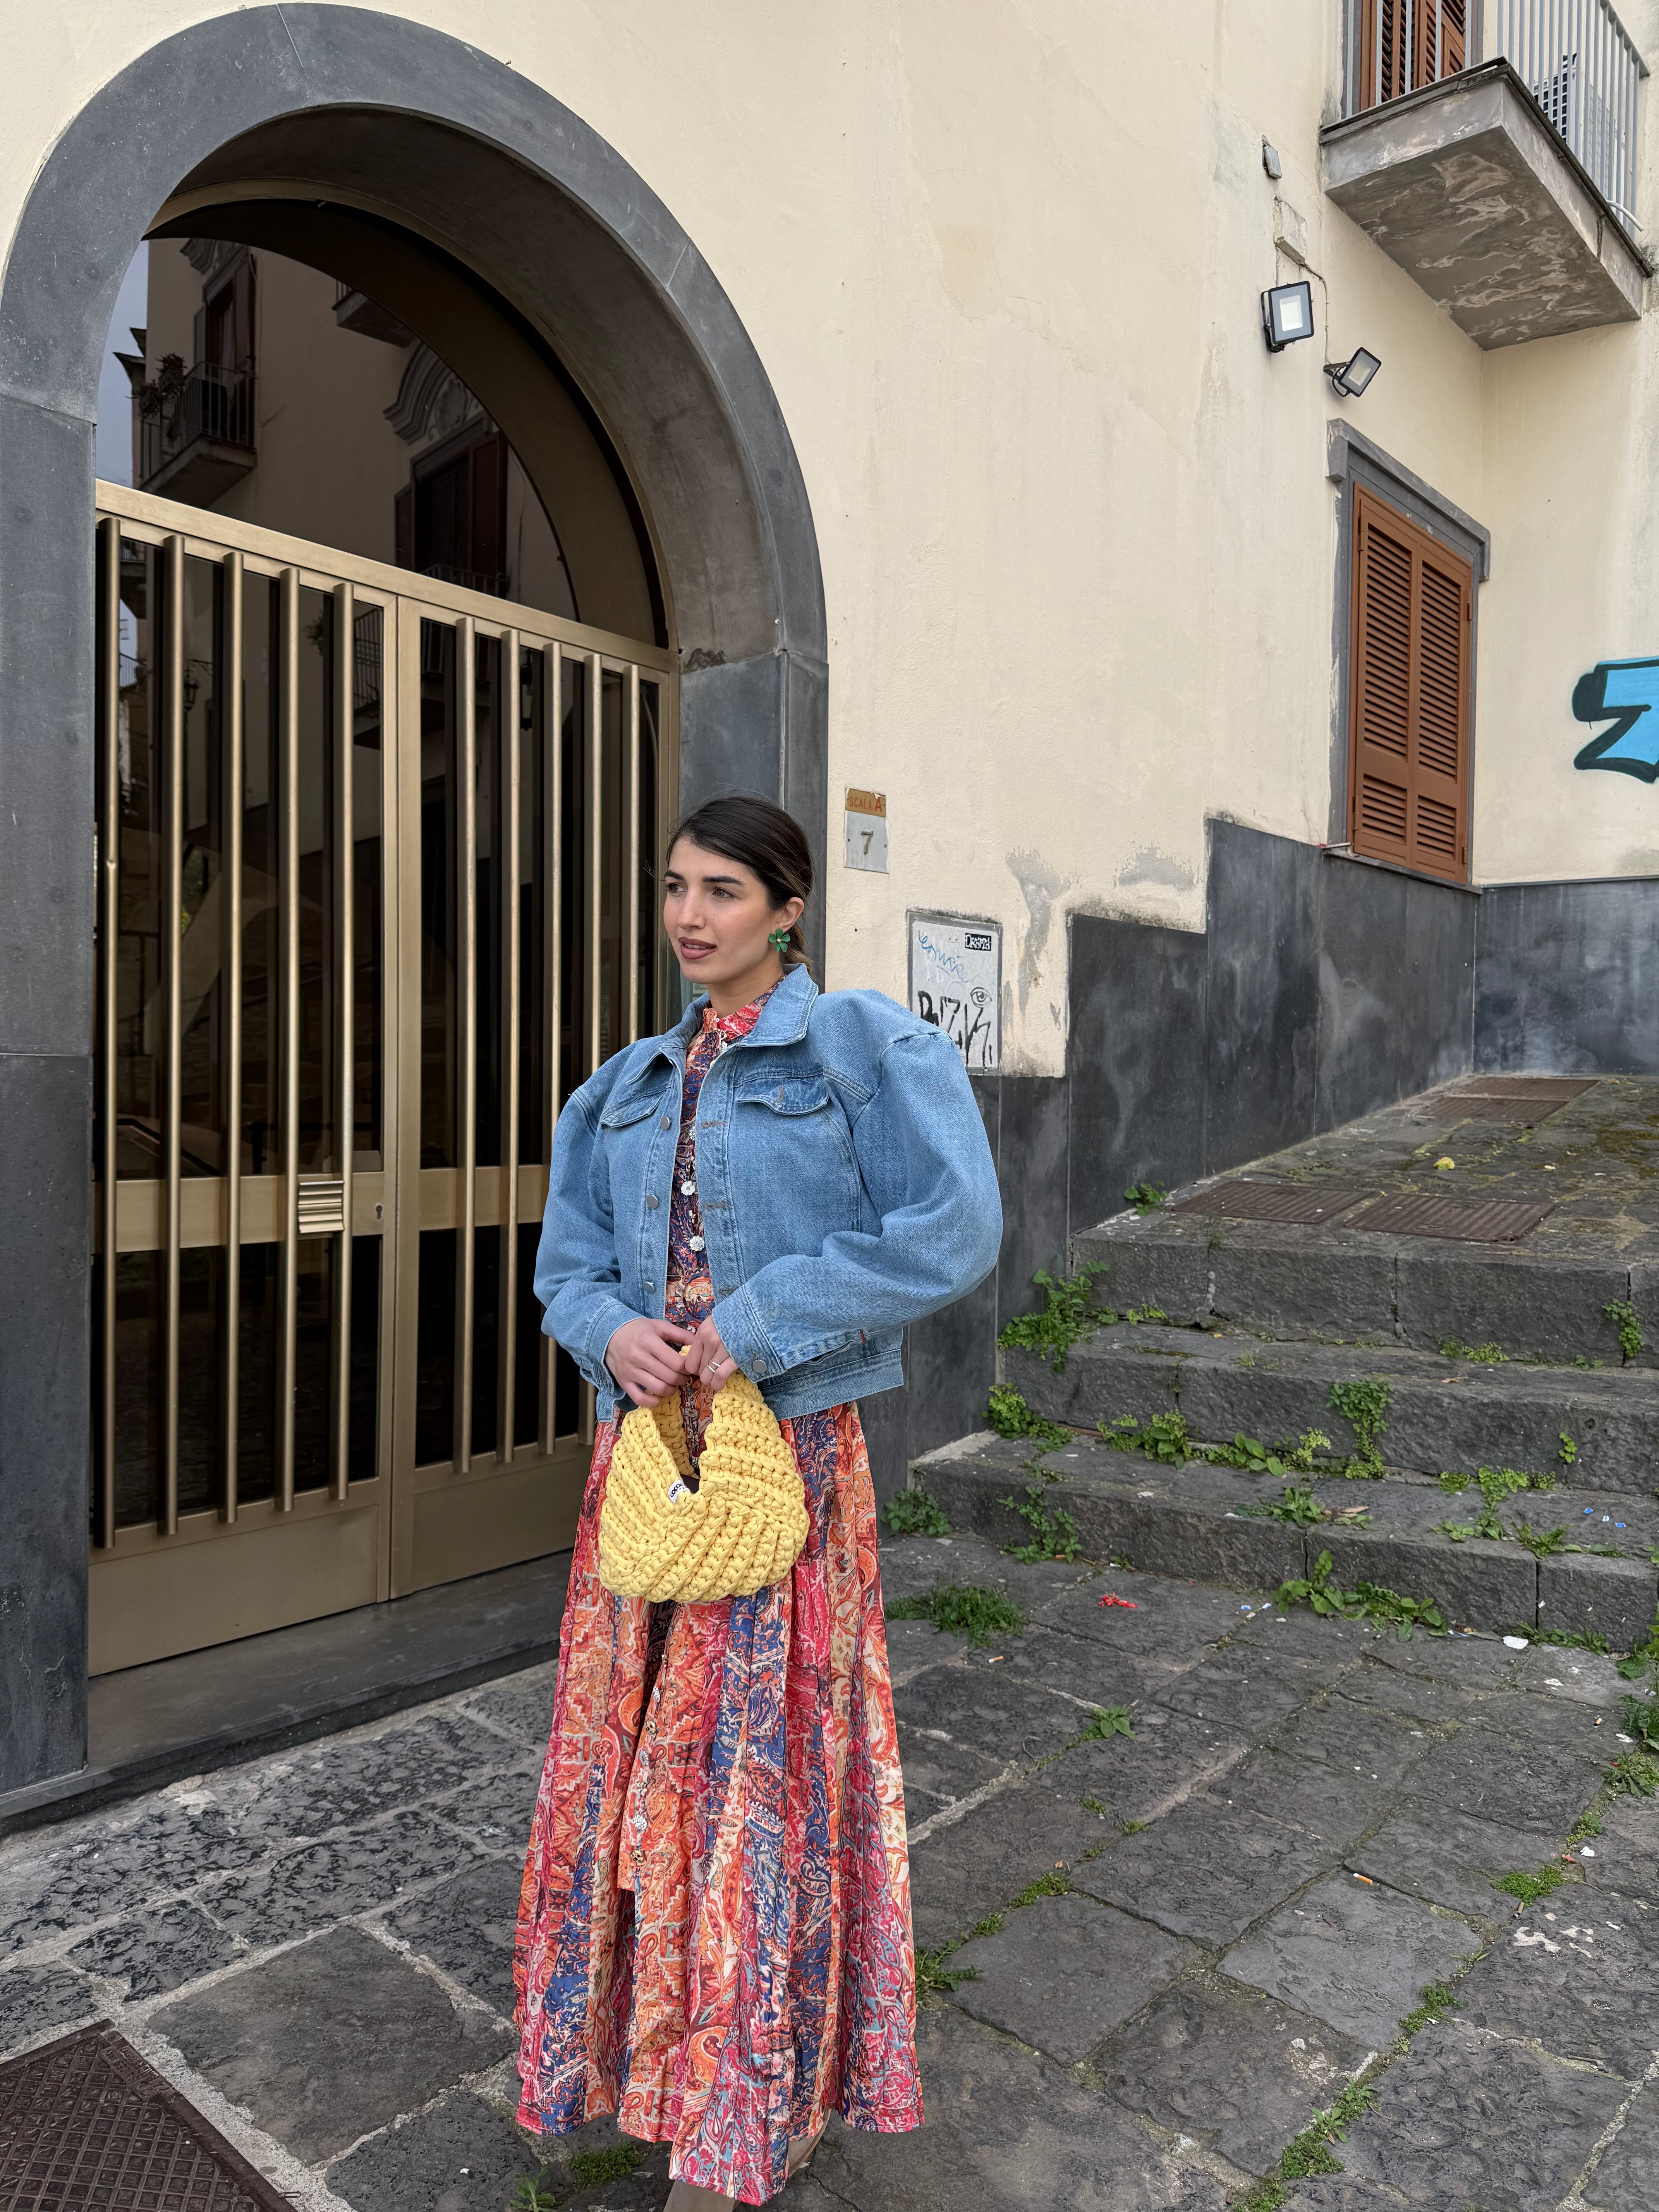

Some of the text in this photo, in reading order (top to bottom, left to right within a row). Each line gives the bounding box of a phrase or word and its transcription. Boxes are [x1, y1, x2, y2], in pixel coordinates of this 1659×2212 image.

[850, 797, 882, 812] SCALA A
[861, 831, 874, 855] 7
